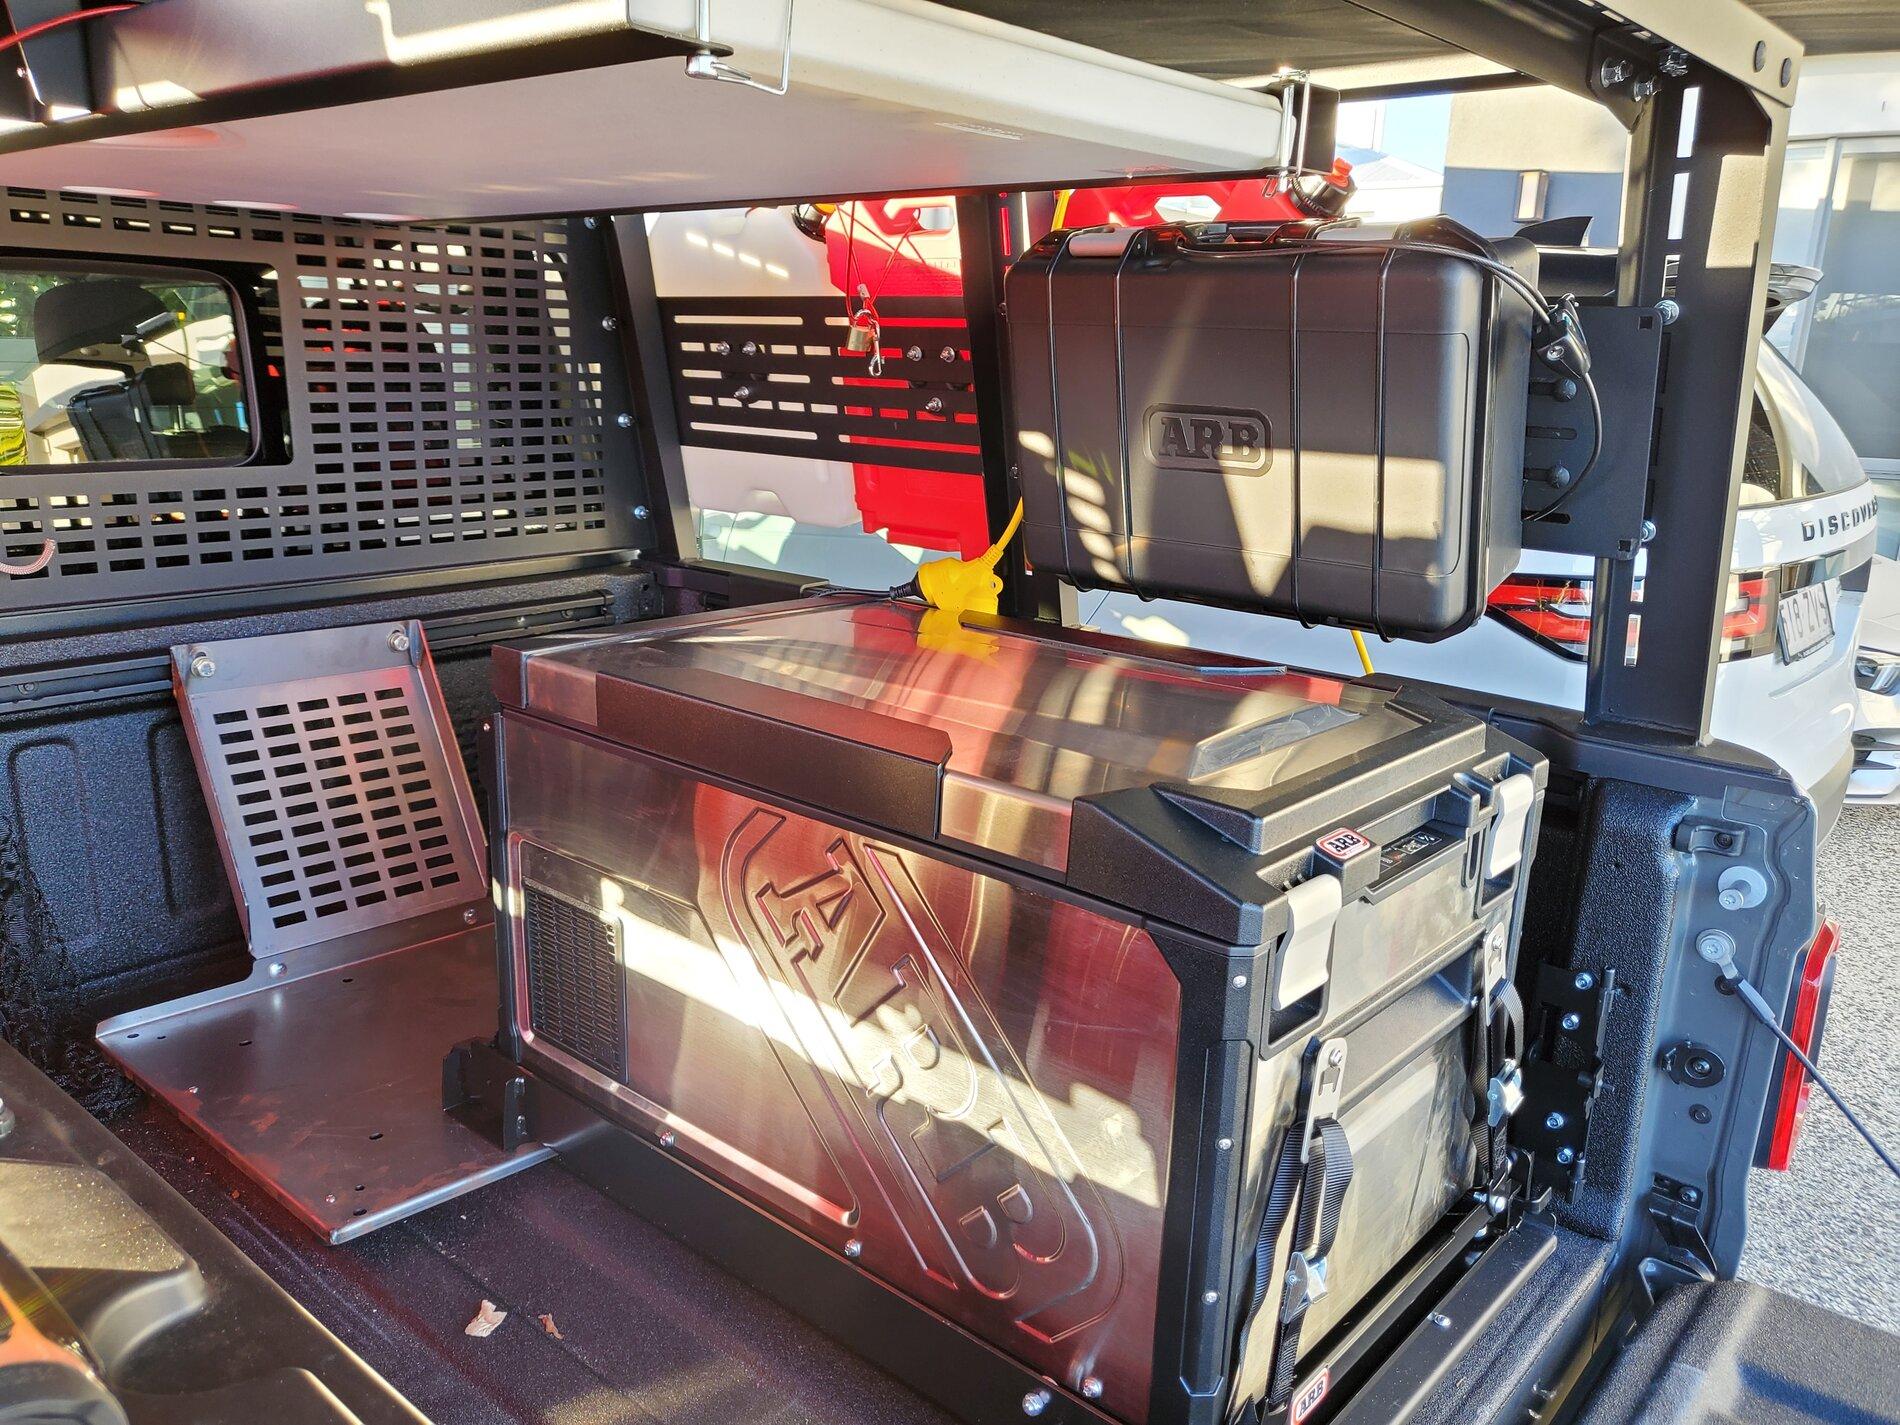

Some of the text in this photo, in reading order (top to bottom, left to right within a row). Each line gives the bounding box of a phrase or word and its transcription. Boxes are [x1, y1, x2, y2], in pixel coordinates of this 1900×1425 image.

[1160, 417, 1262, 463] ARB
[1328, 834, 1361, 852] ARB
[755, 836, 1066, 1301] ARB
[1298, 1381, 1324, 1417] ARB
